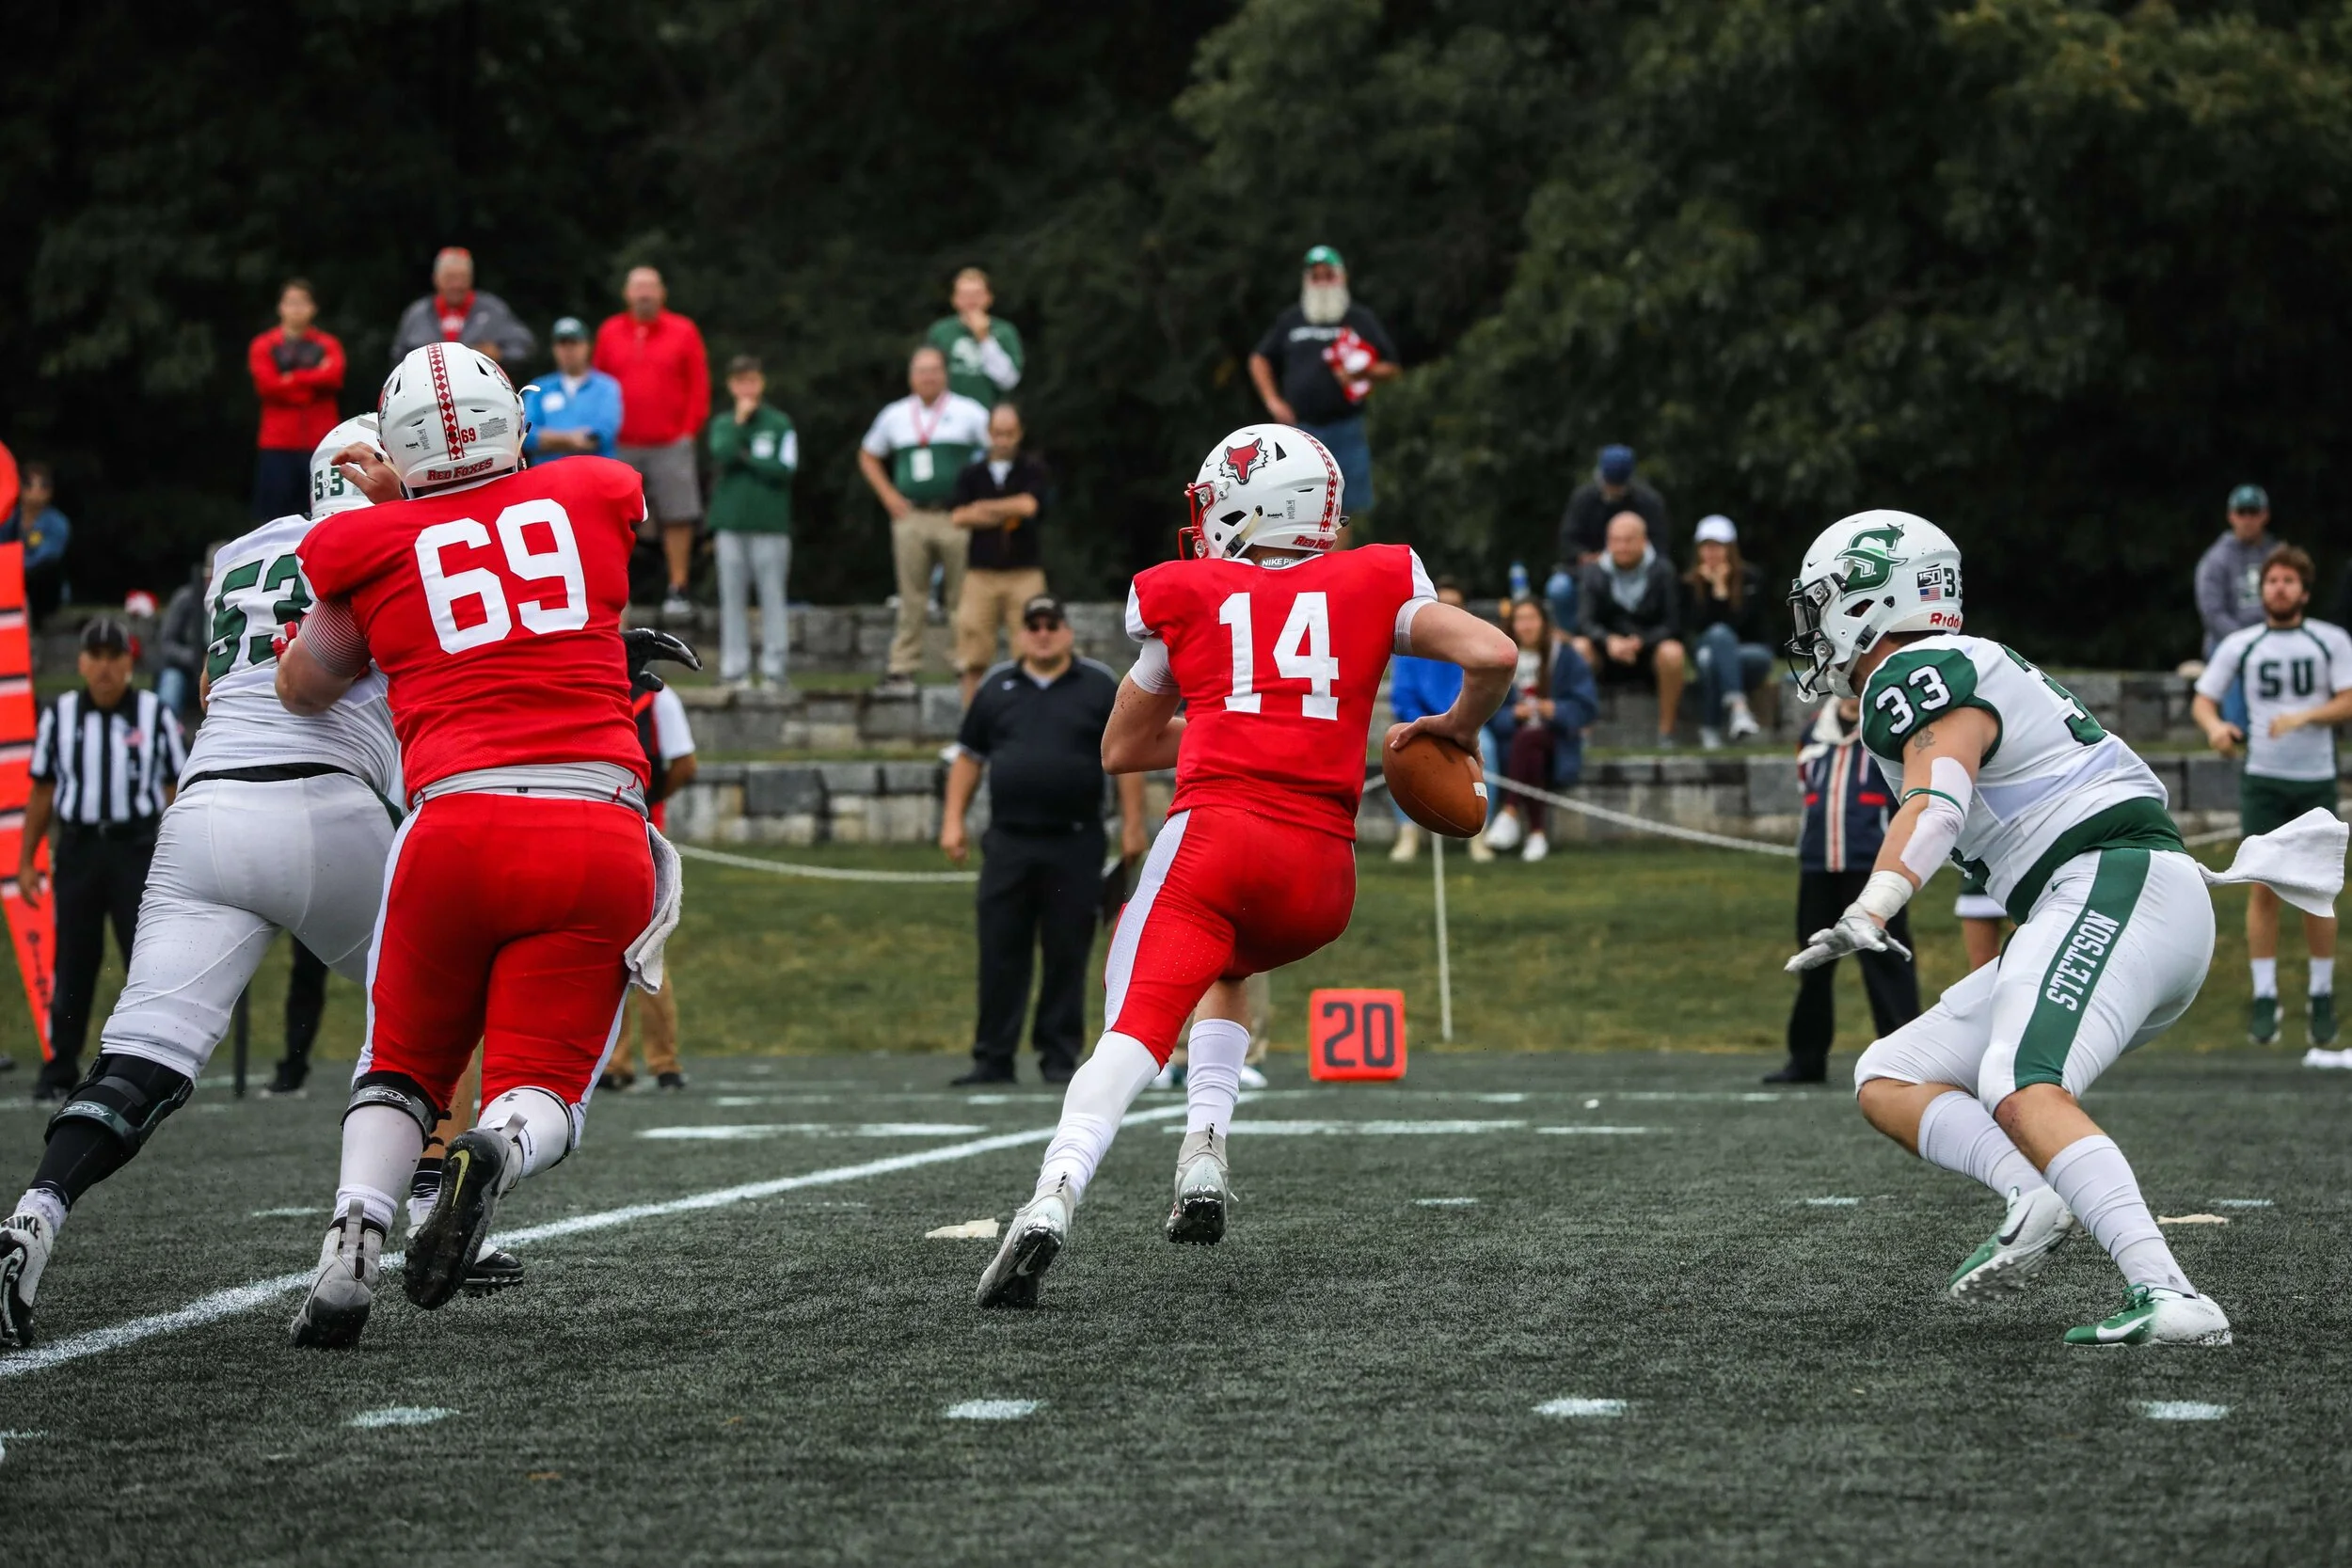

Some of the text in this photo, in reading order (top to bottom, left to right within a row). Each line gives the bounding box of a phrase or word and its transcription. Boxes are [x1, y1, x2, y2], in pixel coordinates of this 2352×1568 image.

[460, 427, 477, 444] 69
[314, 467, 344, 501] 53
[414, 498, 590, 655] 69
[1262, 558, 1282, 566] NIKE
[1917, 570, 1941, 586] 150
[207, 553, 312, 684] 53
[1219, 592, 1340, 721] 14
[2259, 658, 2314, 698] SU
[1875, 665, 1952, 736] 33
[2045, 909, 2121, 1012] STETSON
[1323, 1002, 1395, 1067] 20
